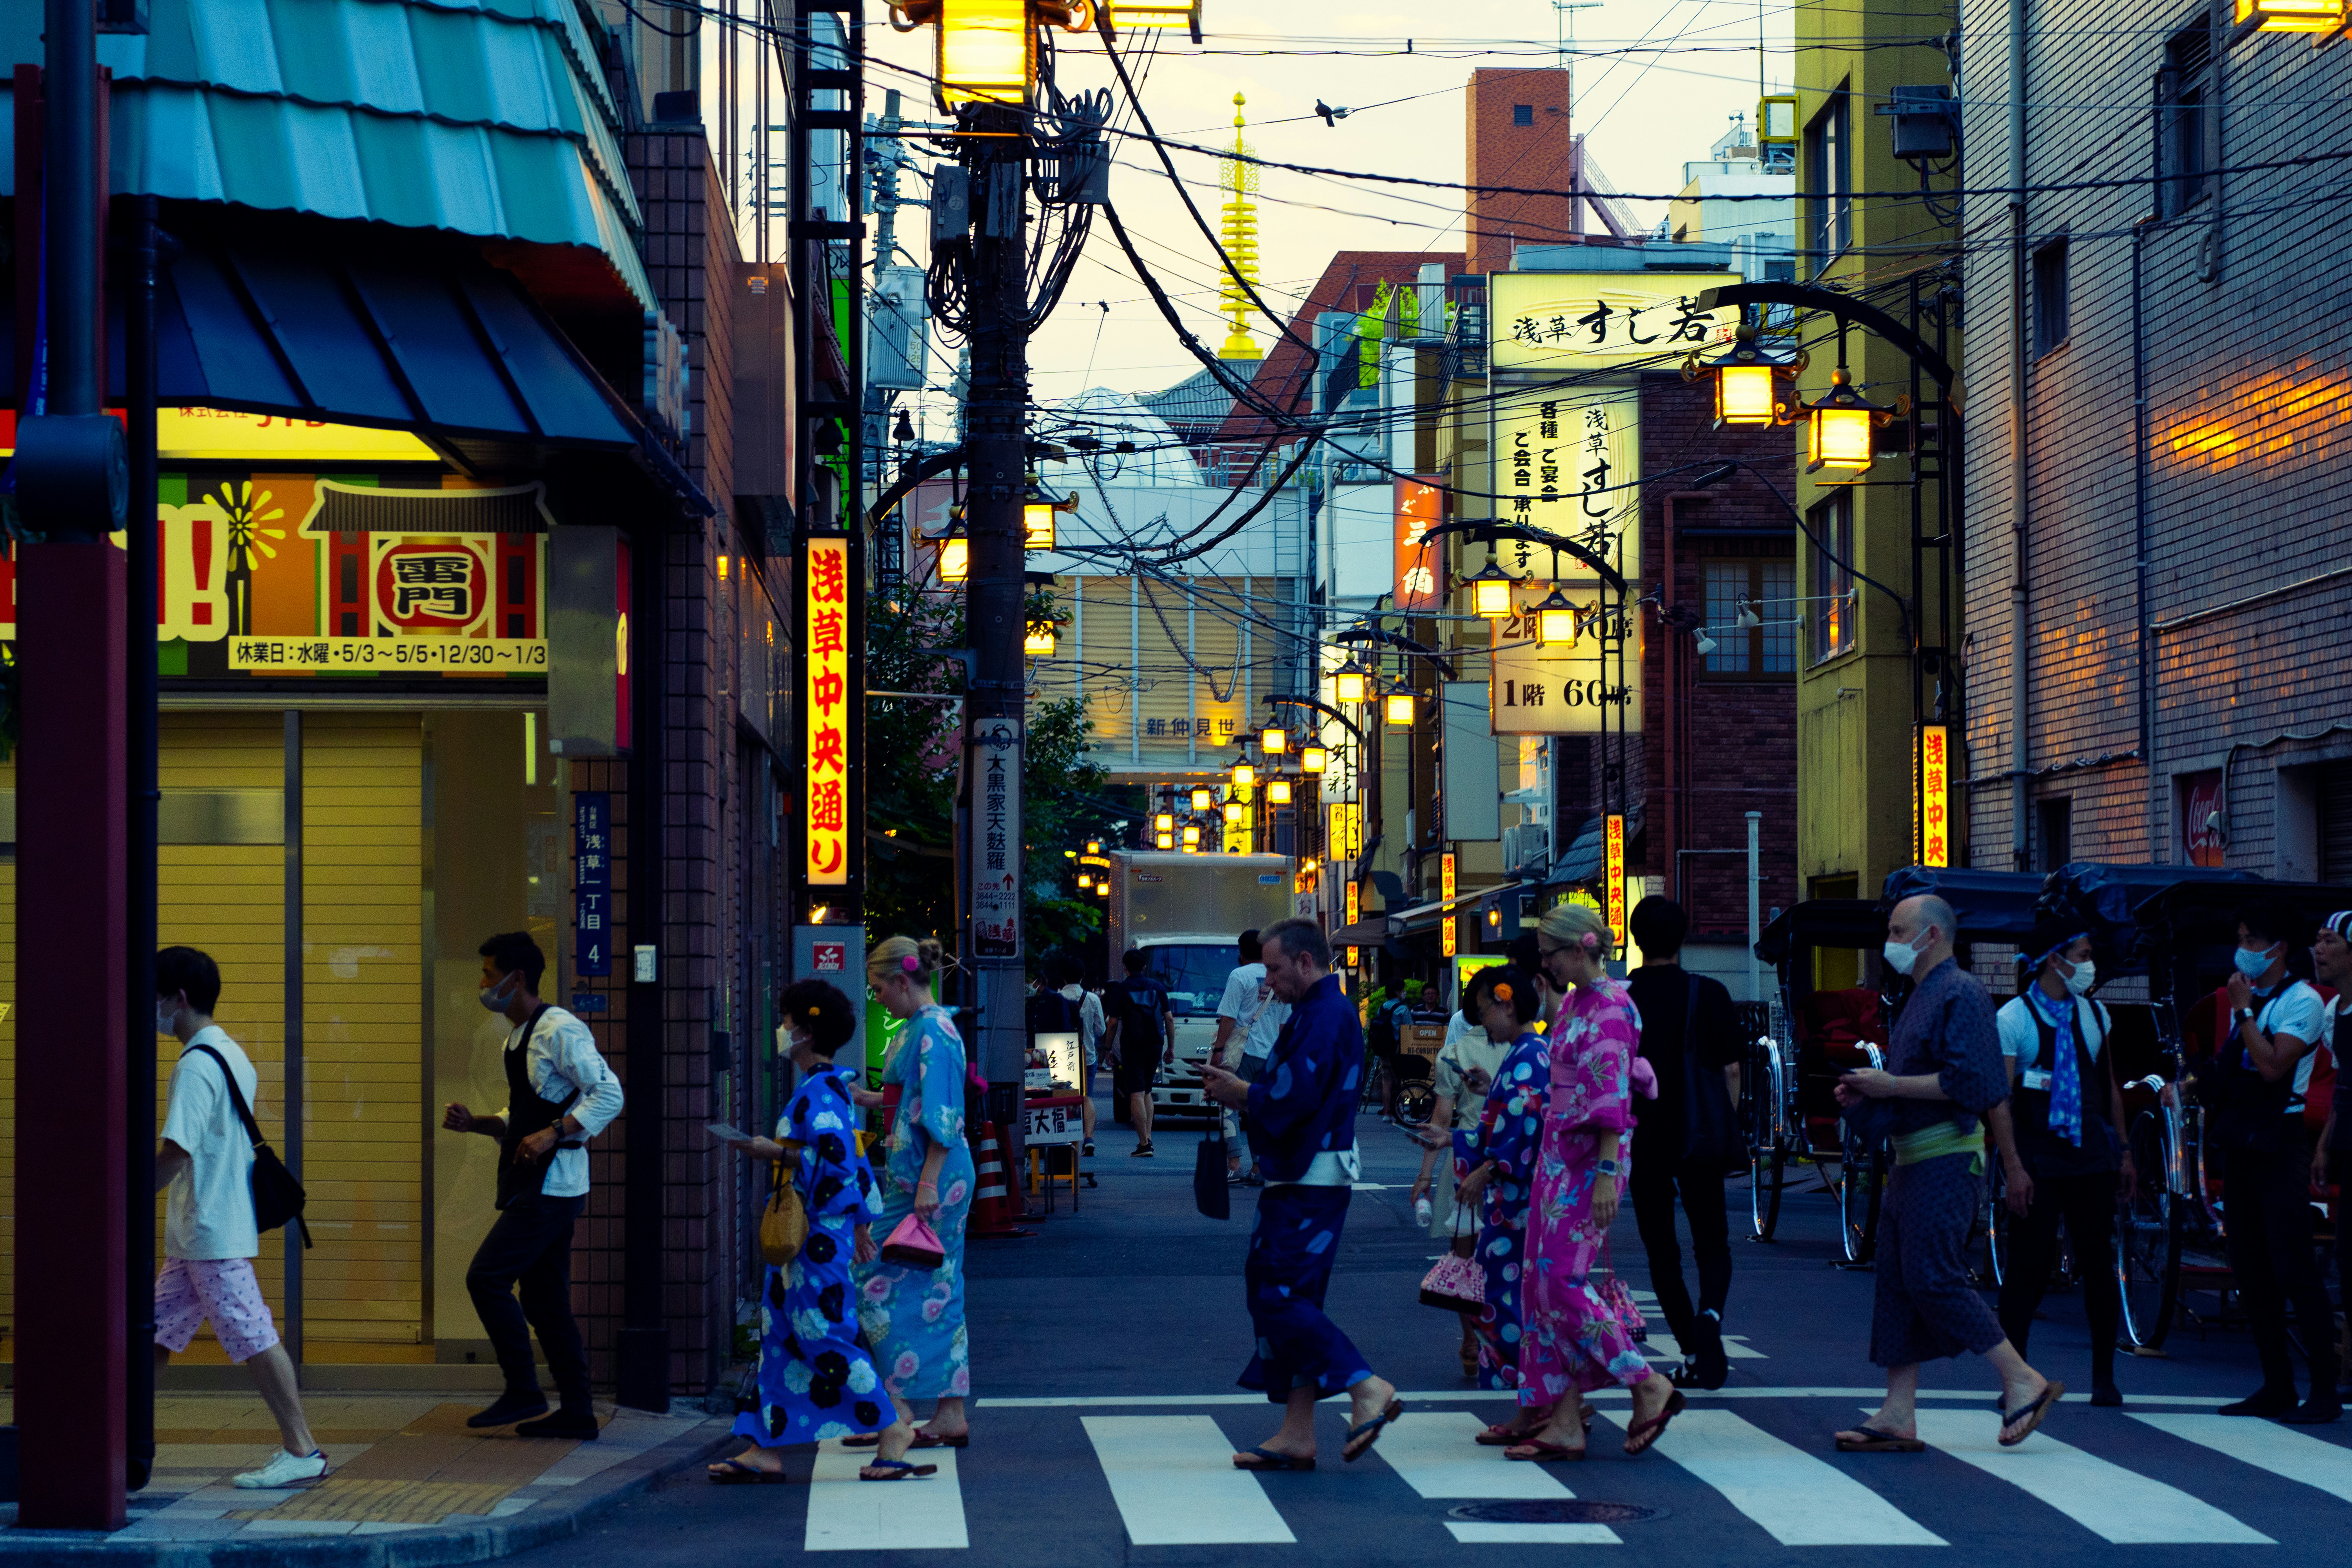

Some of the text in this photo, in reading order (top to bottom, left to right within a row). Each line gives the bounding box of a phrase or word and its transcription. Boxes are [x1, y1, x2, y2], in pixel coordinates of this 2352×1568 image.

[1513, 296, 1715, 344] 浅草すし若
[395, 556, 469, 615] 雷門
[1503, 679, 1545, 707] 1階
[811, 549, 844, 873] 浅草中央通り
[1147, 717, 1235, 736] 新仲見世
[987, 754, 1006, 870] 大黒家天麩羅
[976, 901, 1015, 909] 38441111
[588, 944, 600, 963] 4
[1066, 1041, 1075, 1071] 江戸前
